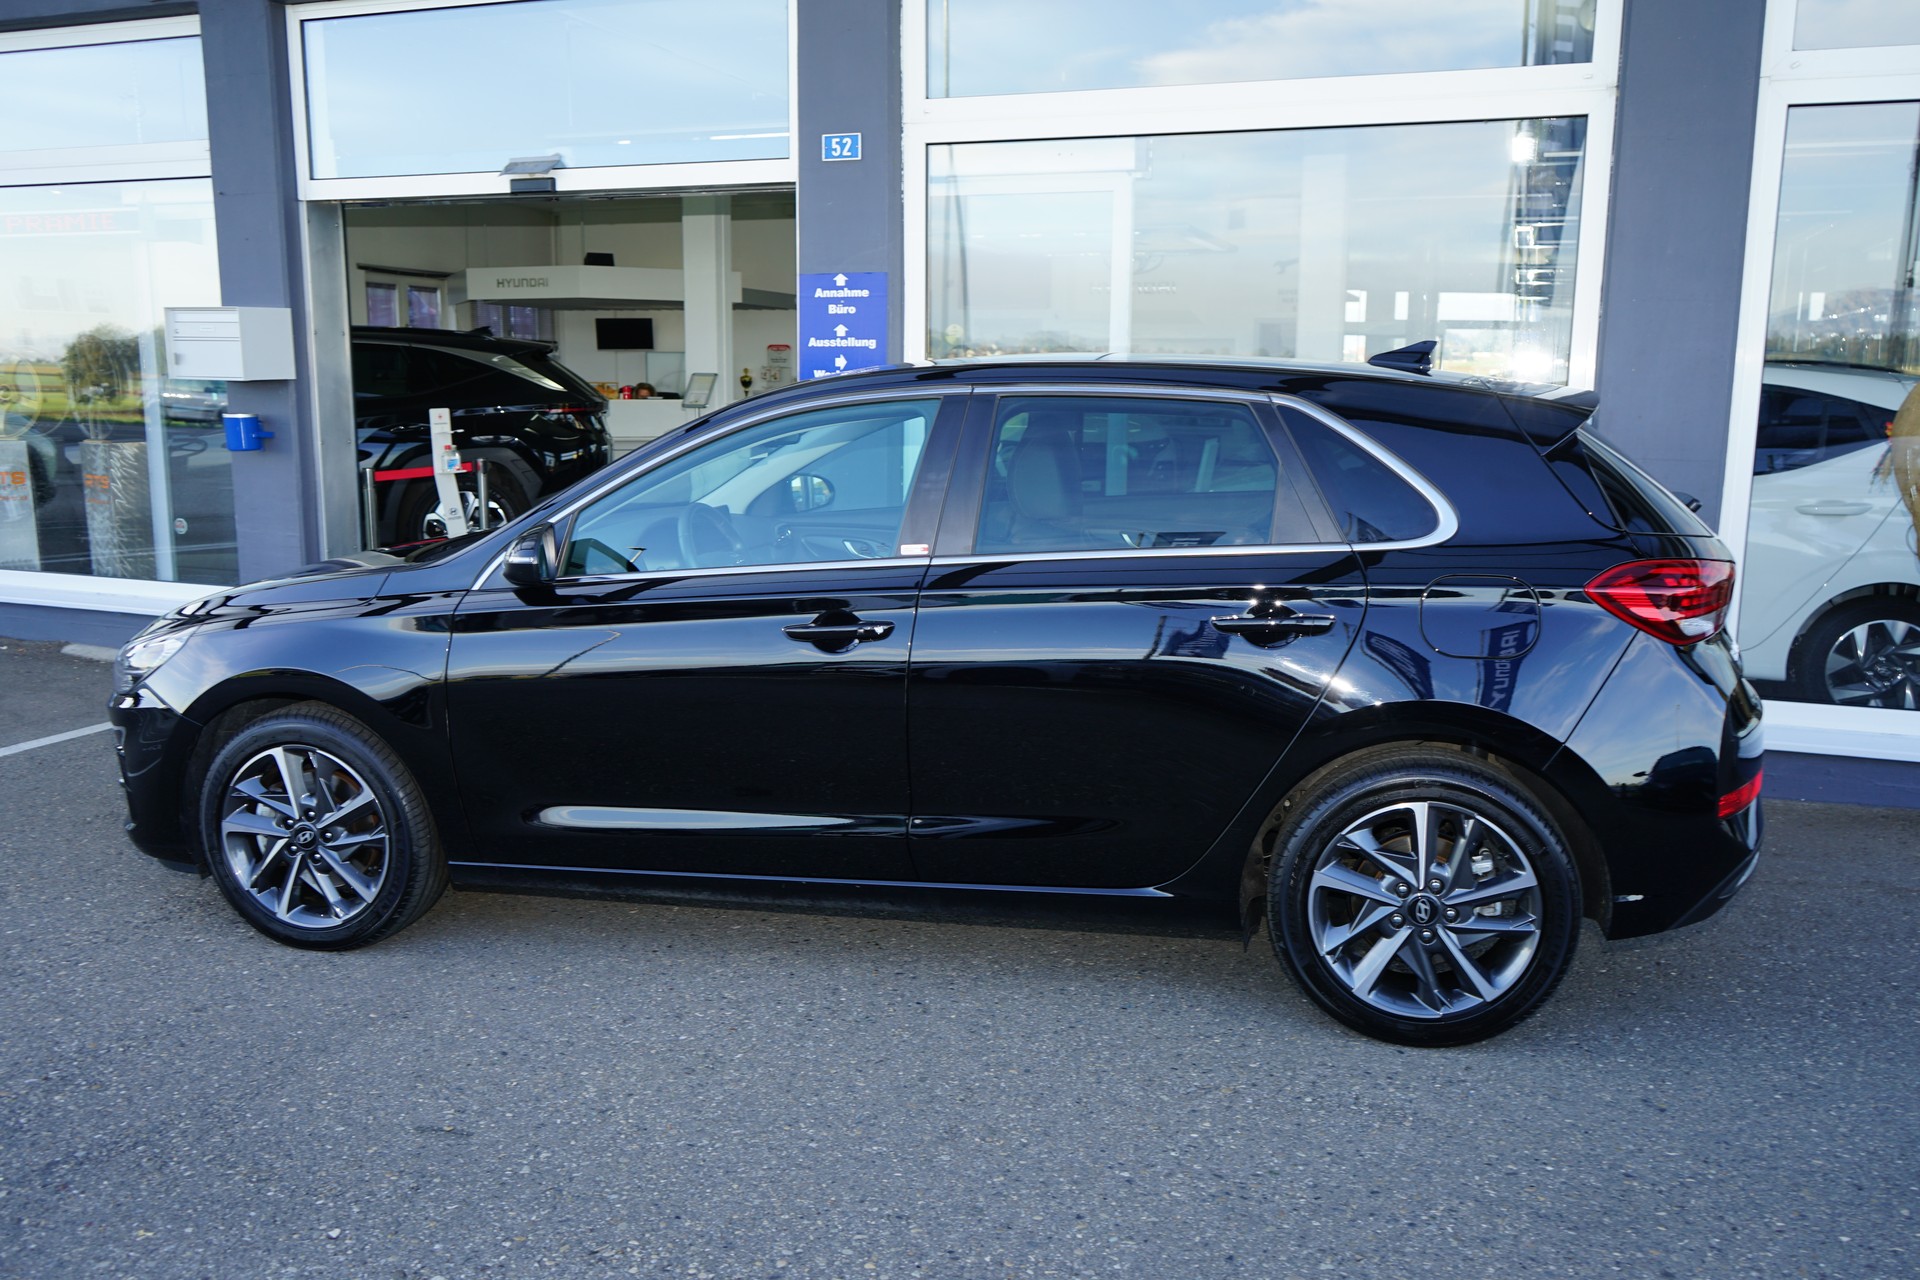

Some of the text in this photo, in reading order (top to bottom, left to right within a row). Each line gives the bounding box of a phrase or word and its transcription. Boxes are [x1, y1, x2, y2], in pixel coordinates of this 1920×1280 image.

[831, 137, 852, 157] 52
[496, 278, 549, 288] HYUNDAI
[814, 287, 870, 298] Annahme
[827, 304, 856, 315] Büro
[808, 337, 877, 350] Ausstellung
[1489, 630, 1521, 711] YUNDAI
